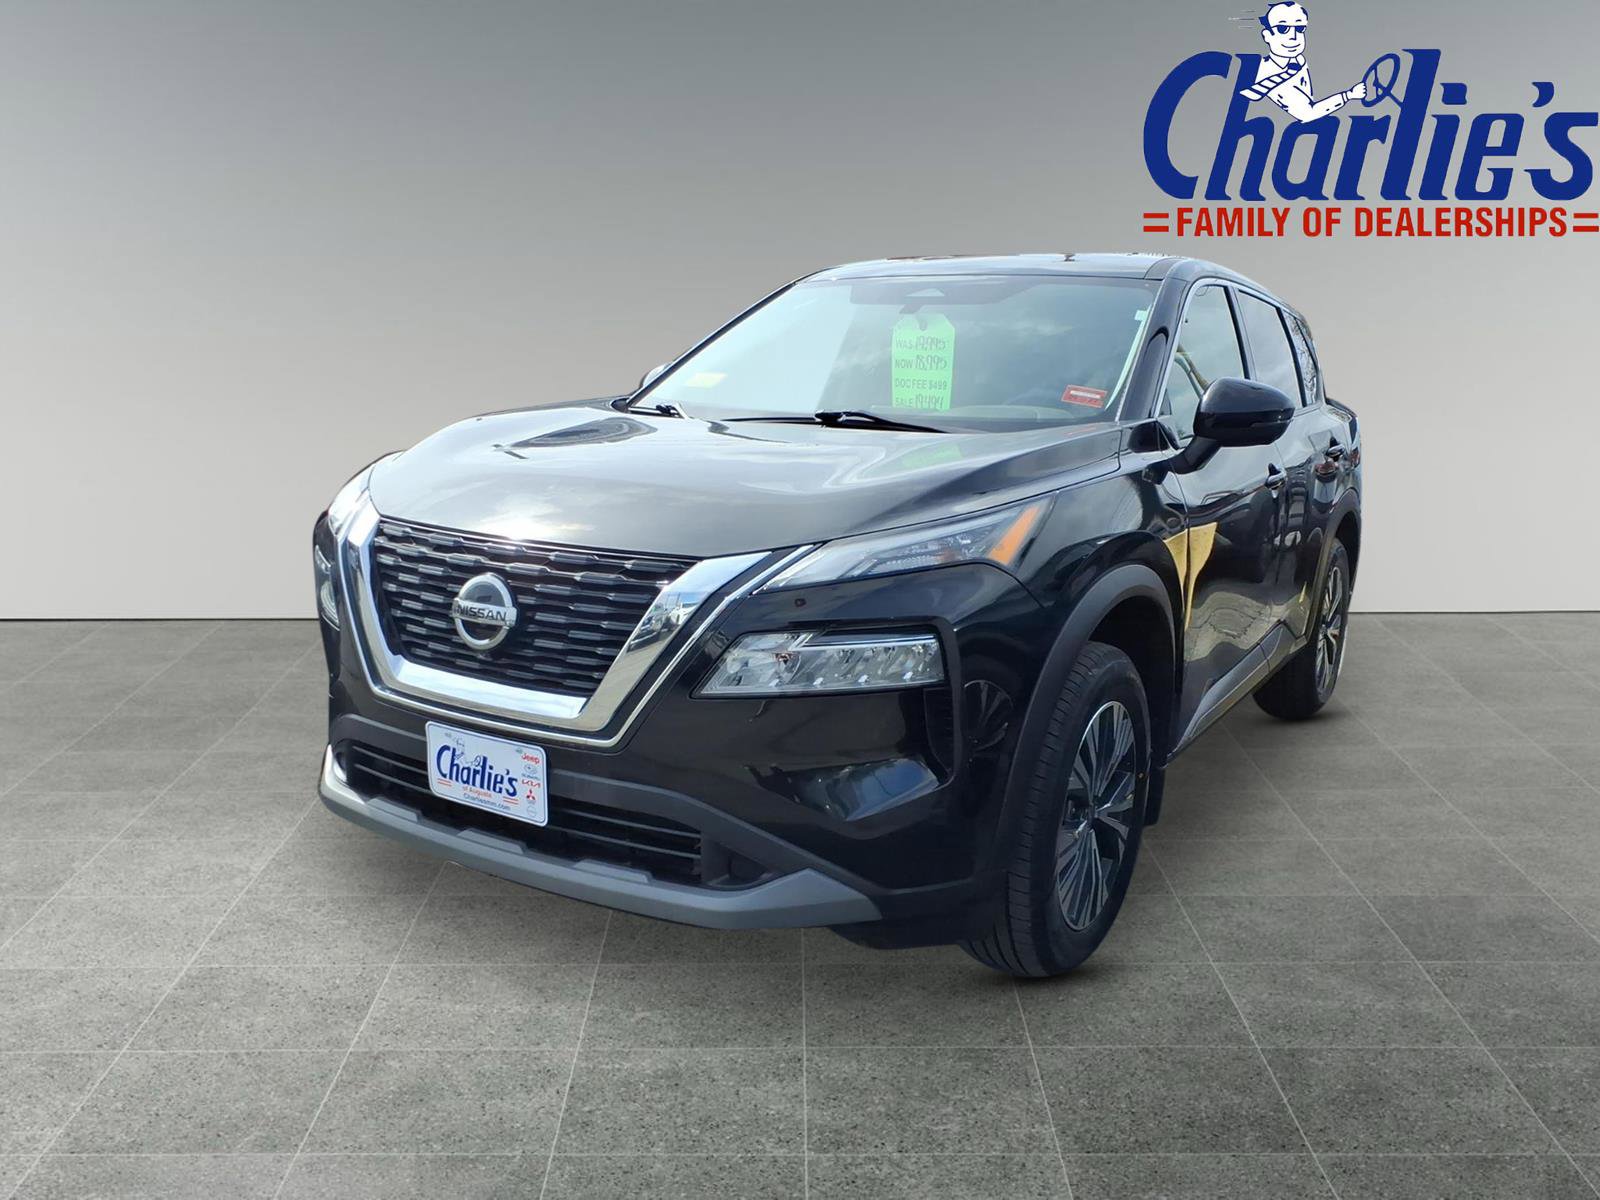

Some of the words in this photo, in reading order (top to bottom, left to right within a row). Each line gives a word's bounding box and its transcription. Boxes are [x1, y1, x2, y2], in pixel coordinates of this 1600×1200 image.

[895, 359, 913, 369] NOW
[895, 378, 911, 389] DOC
[912, 379, 928, 389] FEE
[456, 604, 507, 622] NISSAN
[521, 753, 540, 765] Jeep
[436, 744, 518, 797] Charlie's
